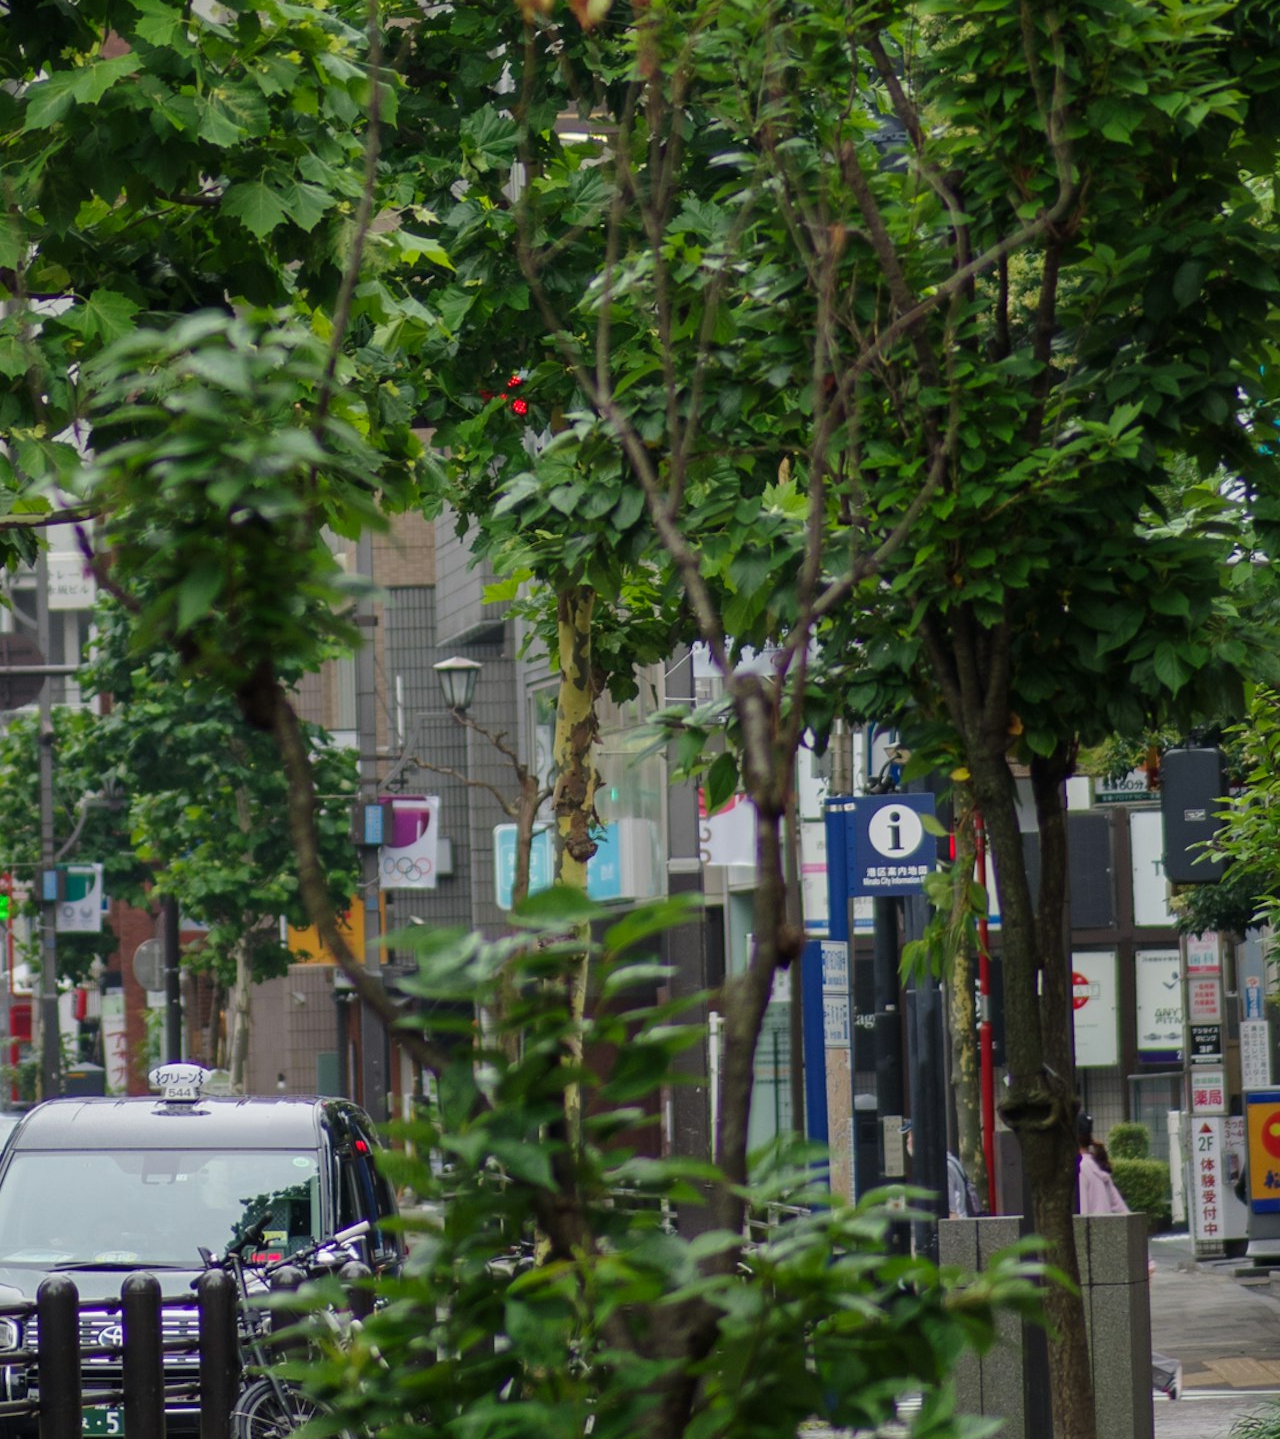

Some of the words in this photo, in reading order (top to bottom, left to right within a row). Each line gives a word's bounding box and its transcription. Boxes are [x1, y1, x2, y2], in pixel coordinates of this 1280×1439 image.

[867, 865, 928, 877] 港区案内地図
[1199, 1045, 1213, 1053] 3F
[161, 1072, 198, 1084] グリーン
[169, 1088, 191, 1098] 544
[1194, 1090, 1222, 1106] 薬局
[1198, 1136, 1214, 1152] 2F
[1200, 1158, 1218, 1236] 体験受付中
